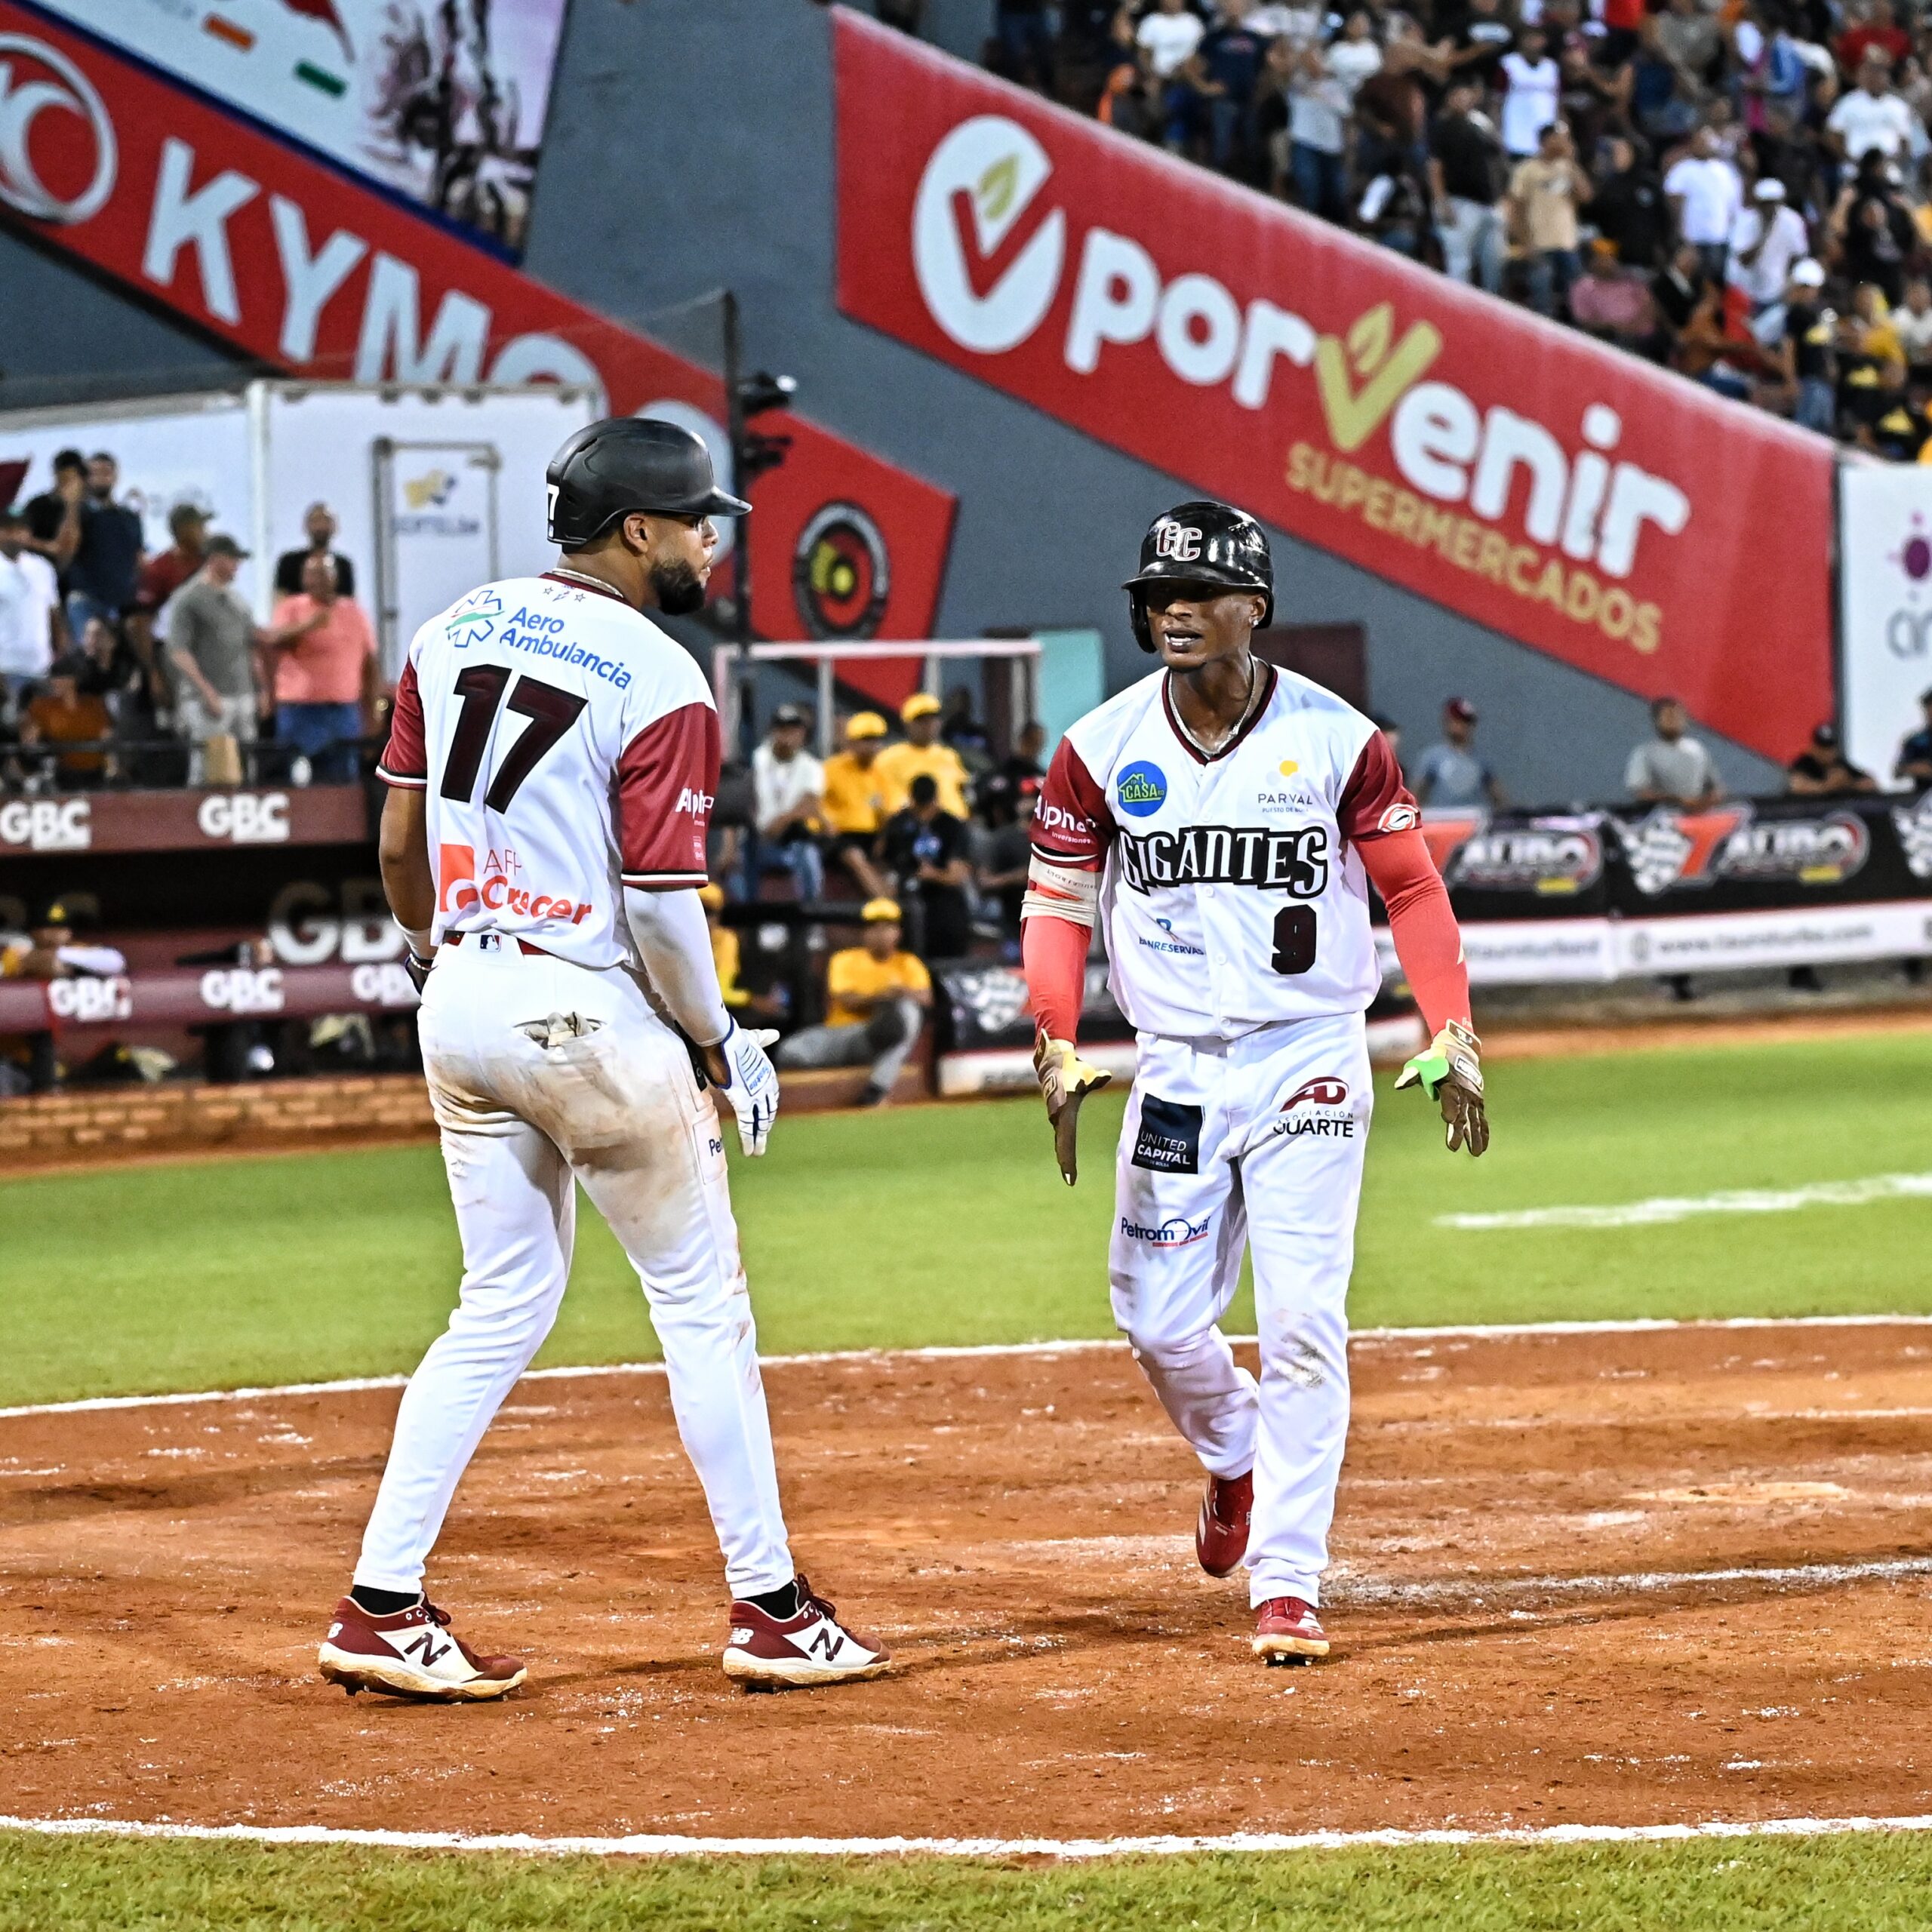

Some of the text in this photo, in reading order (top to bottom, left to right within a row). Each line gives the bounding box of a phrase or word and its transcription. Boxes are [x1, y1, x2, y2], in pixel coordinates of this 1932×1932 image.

[1156, 522, 1202, 561] GC
[1287, 441, 1661, 654] SUPERMERCADOS
[508, 607, 565, 634] Aero
[499, 628, 632, 690] Ambulancia
[440, 663, 589, 815] 17
[1126, 783, 1157, 798] CASA
[1258, 793, 1312, 804] PARVAL
[1, 800, 91, 851] GBC
[198, 792, 291, 843] GBC
[1052, 832, 1092, 844] Inversiones
[1118, 826, 1327, 898] GIGANTES
[267, 878, 408, 965] GB
[1272, 904, 1316, 974] 9
[200, 967, 285, 1014] GBC
[352, 963, 417, 1008] GB
[1137, 1144, 1190, 1164] CAPITAL
[1140, 1131, 1186, 1151] UNITED
